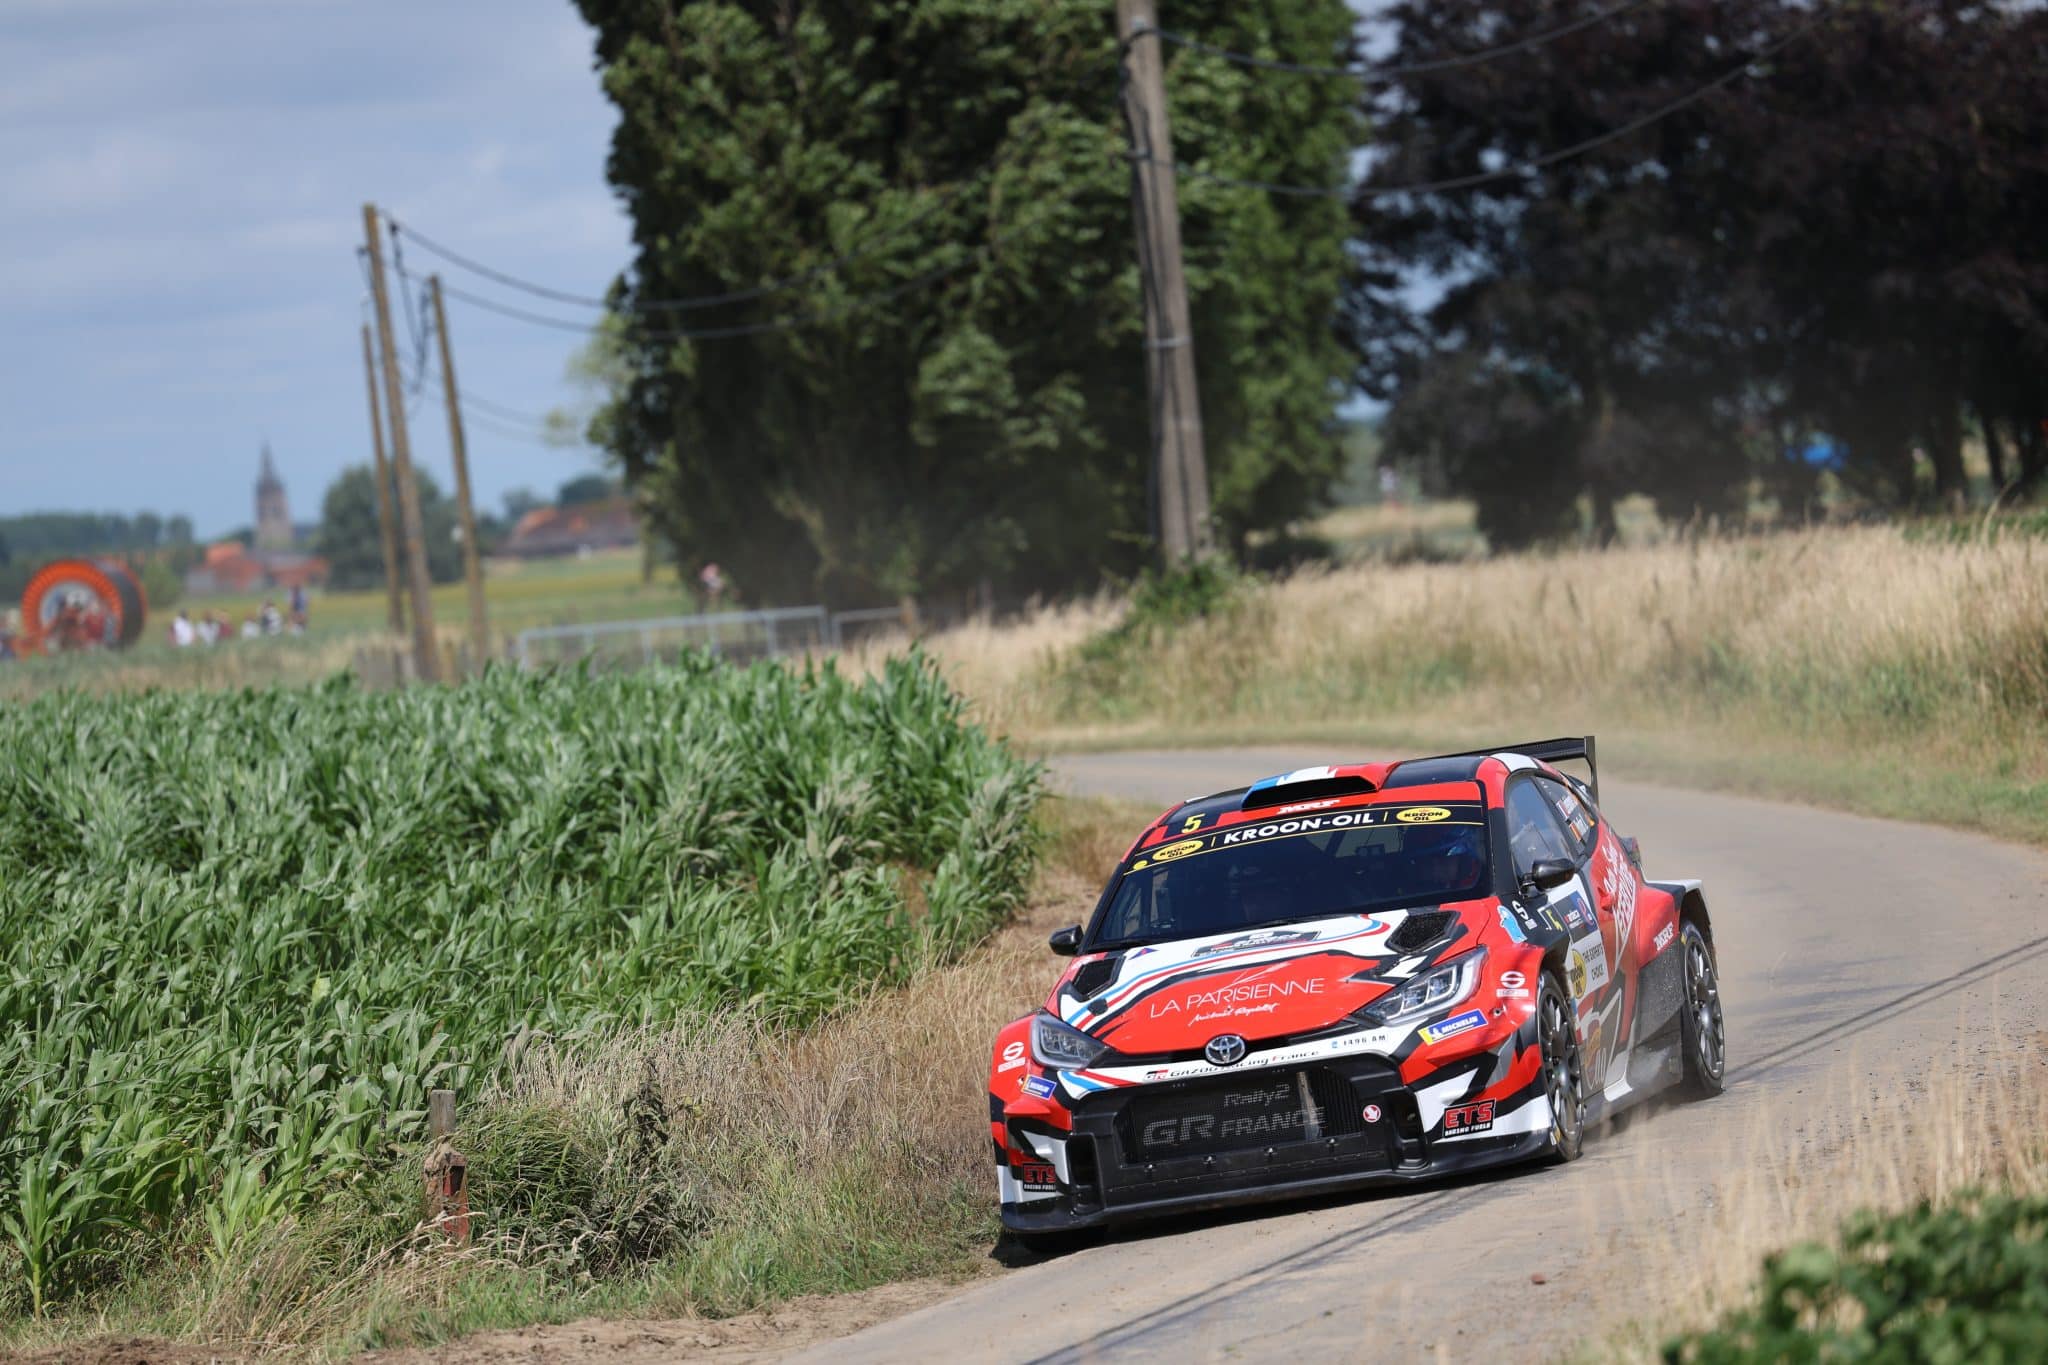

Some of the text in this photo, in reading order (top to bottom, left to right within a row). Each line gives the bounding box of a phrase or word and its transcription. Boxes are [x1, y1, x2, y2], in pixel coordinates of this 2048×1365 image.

[1276, 800, 1340, 814] MRF
[1181, 813, 1205, 834] 5
[1224, 812, 1374, 844] KROON-OIL
[1160, 844, 1196, 856] KROON
[1653, 921, 1674, 950] MRF
[1150, 999, 1181, 1018] LA
[1186, 978, 1325, 1009] PARISIENNE
[1441, 1015, 1478, 1033] MICHELIN
[1224, 1083, 1289, 1107] Rally2
[1143, 1106, 1326, 1146] GR FRANCE
[1445, 1102, 1493, 1128] ETS
[1023, 1165, 1056, 1183] ETS
